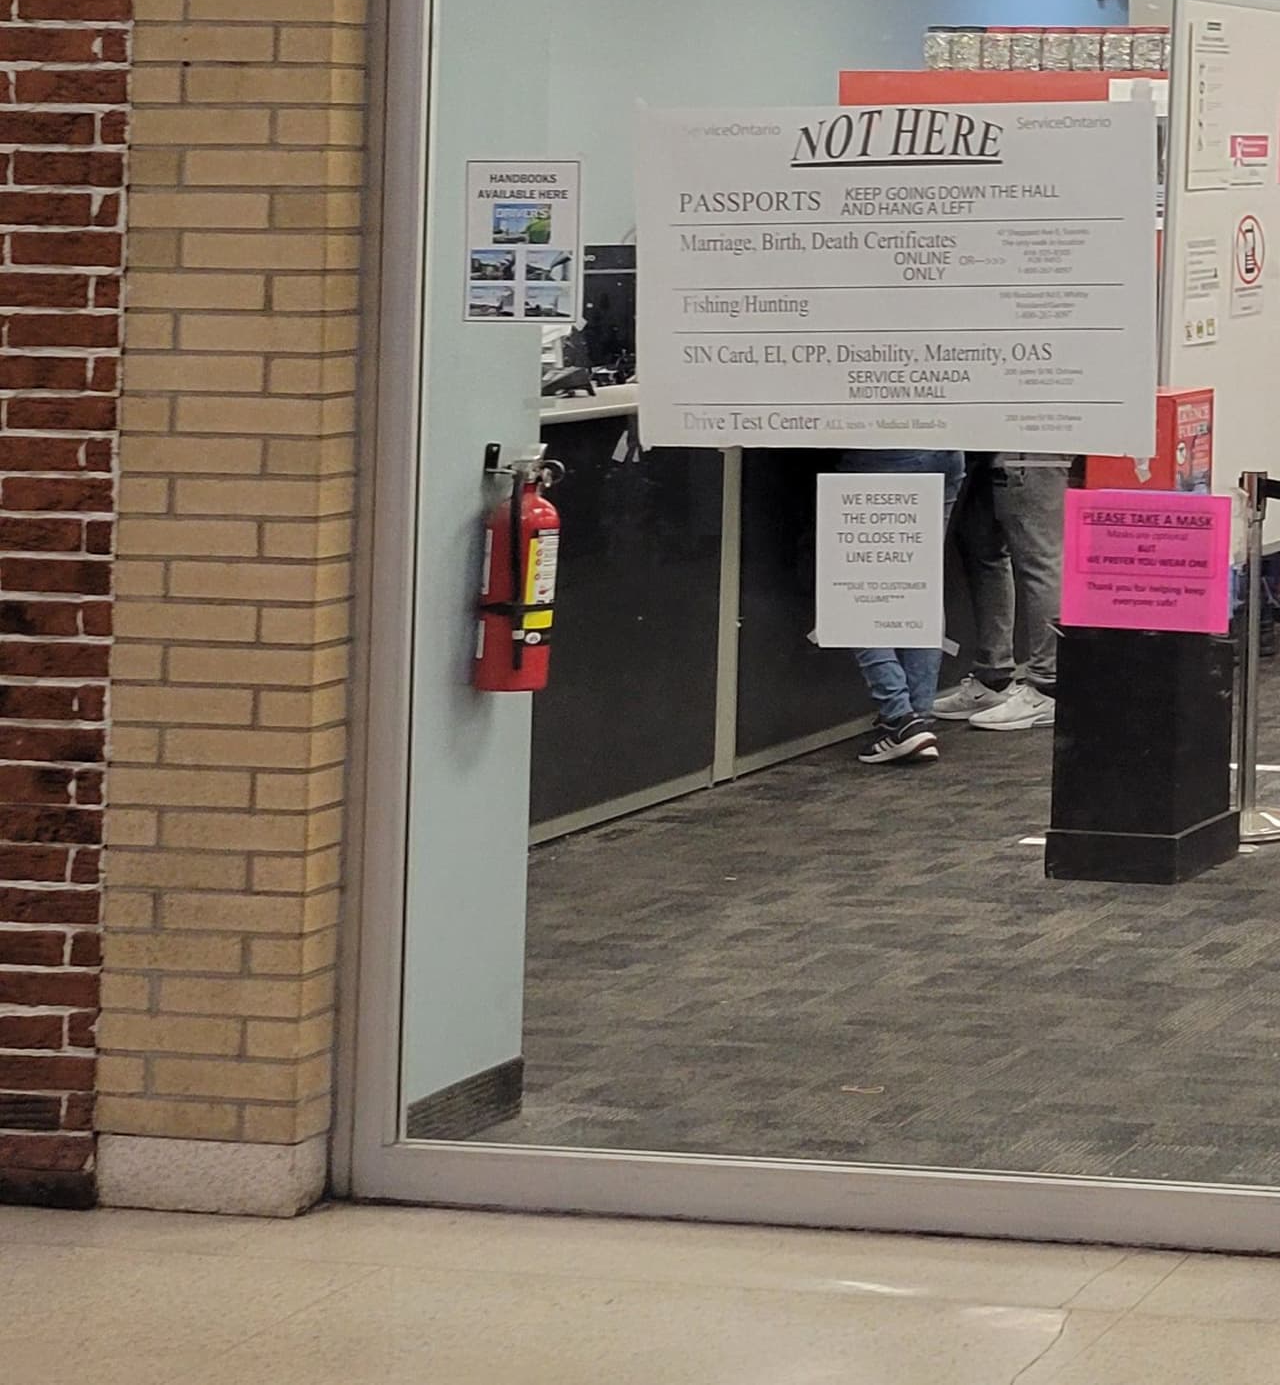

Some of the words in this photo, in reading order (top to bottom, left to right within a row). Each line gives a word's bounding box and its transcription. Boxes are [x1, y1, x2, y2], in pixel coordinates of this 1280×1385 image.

[1016, 116, 1112, 130] ServiceOntario
[791, 110, 882, 161] NOT
[889, 108, 1004, 158] HERE
[490, 174, 557, 183] HANDBOOKS
[478, 190, 536, 199] AVAILABLE
[539, 190, 569, 199] HERE
[845, 187, 881, 201] KEEP
[885, 186, 936, 201] GOING
[938, 185, 986, 200] DOWN
[990, 185, 1017, 198] THE
[1021, 184, 1060, 198] HALL
[679, 191, 821, 213] PASSPORTS
[841, 203, 876, 215] AND
[878, 202, 924, 215] HANG
[926, 202, 938, 214] A
[941, 201, 975, 214] LEFT
[680, 233, 757, 255] Marriage,
[761, 232, 806, 252] Birth,
[811, 231, 859, 251] Death
[863, 230, 957, 250] Certificates
[894, 251, 951, 265] ONLINE
[902, 267, 946, 281] ONLY
[683, 295, 809, 316] Fishing/Hunting
[683, 345, 713, 364] SIN
[717, 344, 759, 365] Card,
[763, 345, 787, 365] EI,
[791, 344, 832, 364] CPP,
[836, 343, 919, 367] Disability,
[924, 343, 1007, 366] Maternity,
[1011, 342, 1053, 362] OAS
[848, 370, 905, 384] SERVICE
[909, 369, 971, 383] CANADA
[848, 386, 911, 399] MIDTOWN
[914, 385, 947, 398] MALL
[683, 412, 725, 431] Drive
[730, 412, 763, 430] Test
[767, 412, 820, 430] Center
[842, 494, 862, 505] WE
[866, 494, 918, 505] RESERVE
[842, 513, 866, 524] THE
[869, 513, 917, 524] OPTION
[1083, 512, 1125, 525] PLEASE
[1130, 513, 1159, 525] TAKE
[1164, 515, 1172, 525] A
[1176, 516, 1212, 527] MASK
[846, 551, 872, 563] LINE
[876, 551, 914, 563] EARLY
